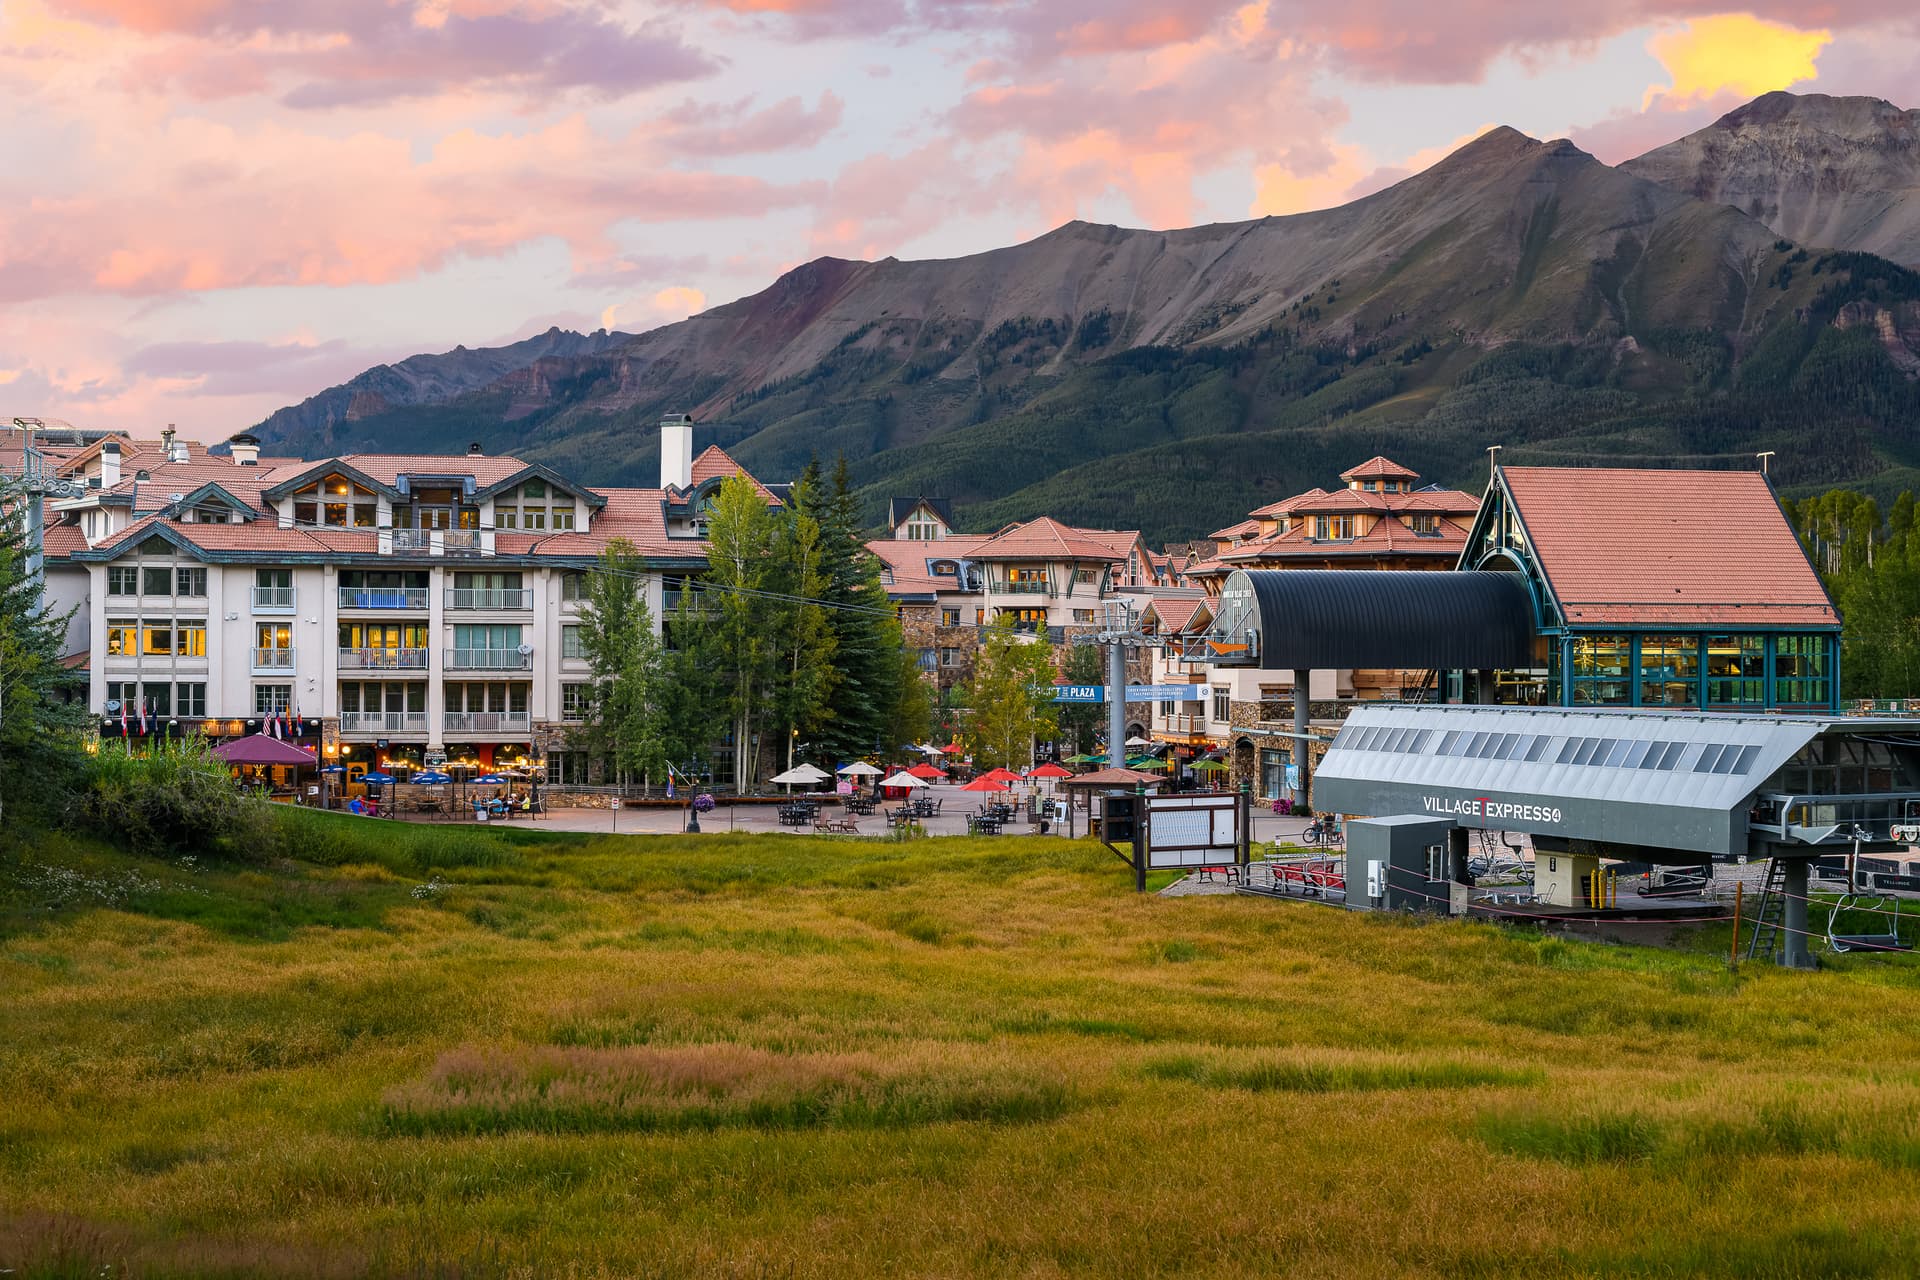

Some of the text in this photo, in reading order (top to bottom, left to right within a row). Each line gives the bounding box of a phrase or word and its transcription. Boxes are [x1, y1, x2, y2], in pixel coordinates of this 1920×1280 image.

[1070, 687, 1095, 697] PLAZA
[1423, 797, 1481, 815] VILLAGE
[1486, 802, 1552, 822] EXPRESS
